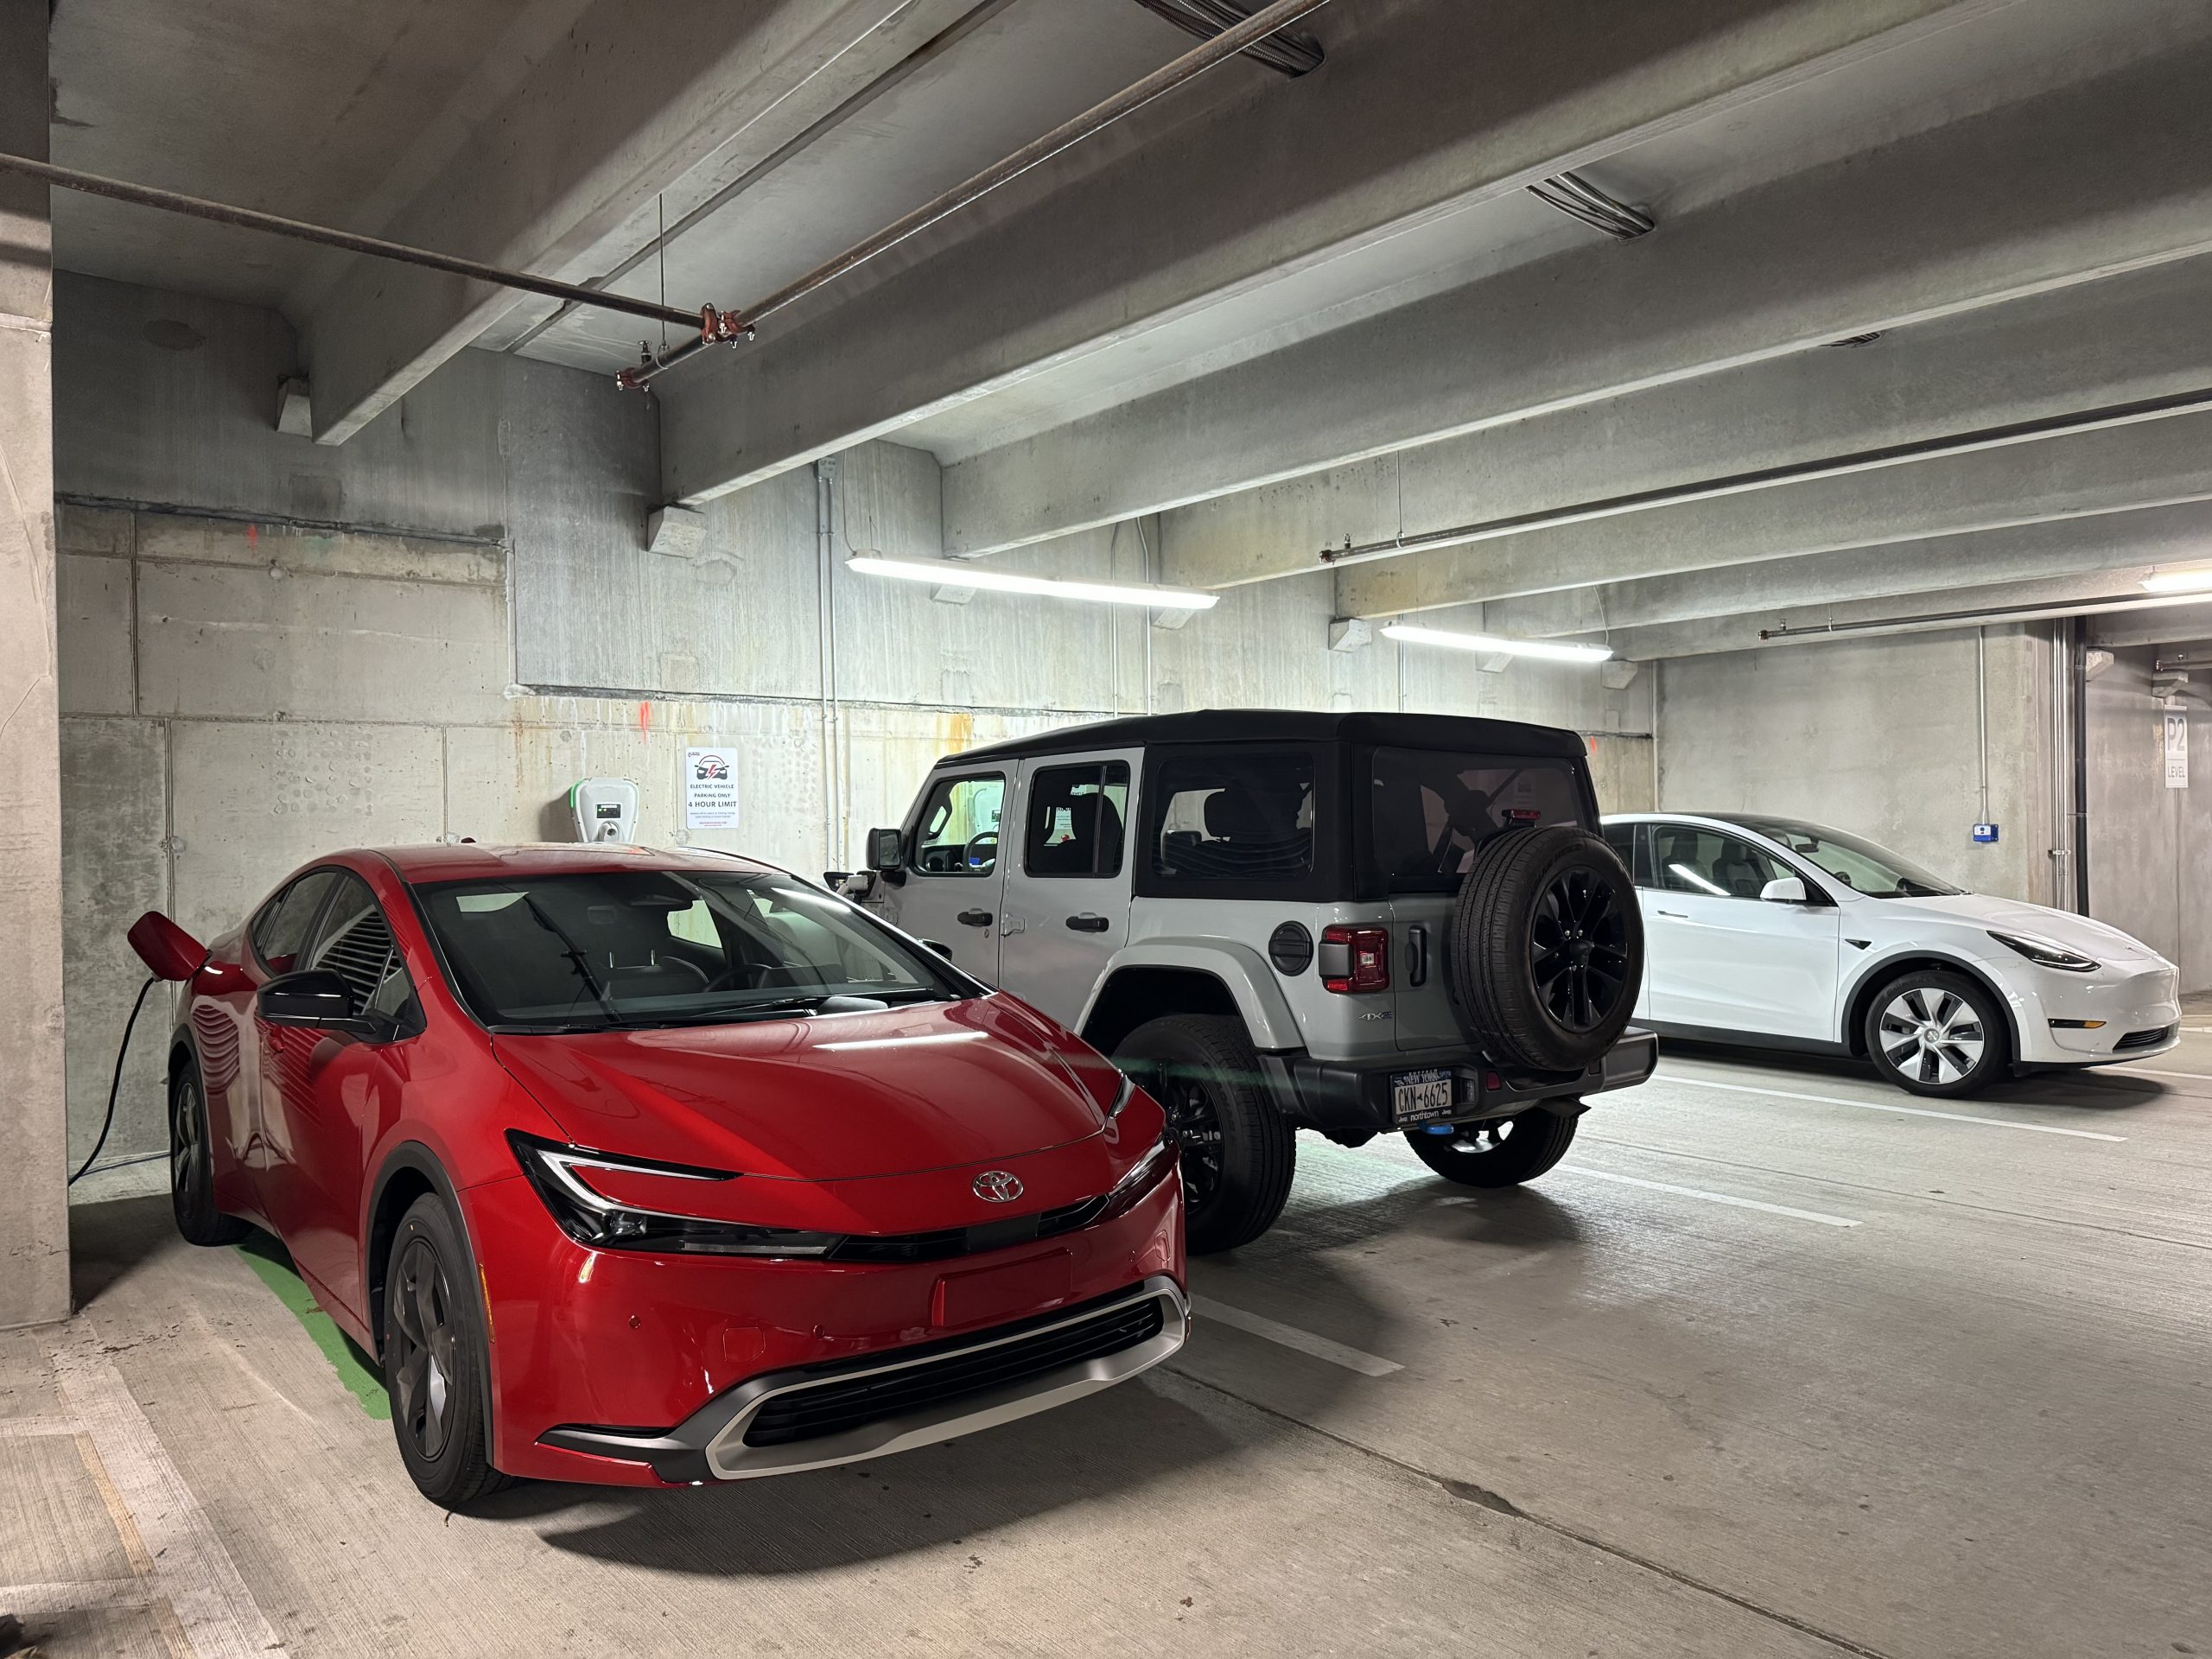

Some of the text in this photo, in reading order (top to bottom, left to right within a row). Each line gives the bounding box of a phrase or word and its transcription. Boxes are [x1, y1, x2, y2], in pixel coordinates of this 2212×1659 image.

[2167, 717, 2185, 751] P2
[2167, 766, 2185, 779] LEVEL
[1404, 1071, 1439, 1085] NEW YORK
[1410, 1110, 1440, 1122] northtown
